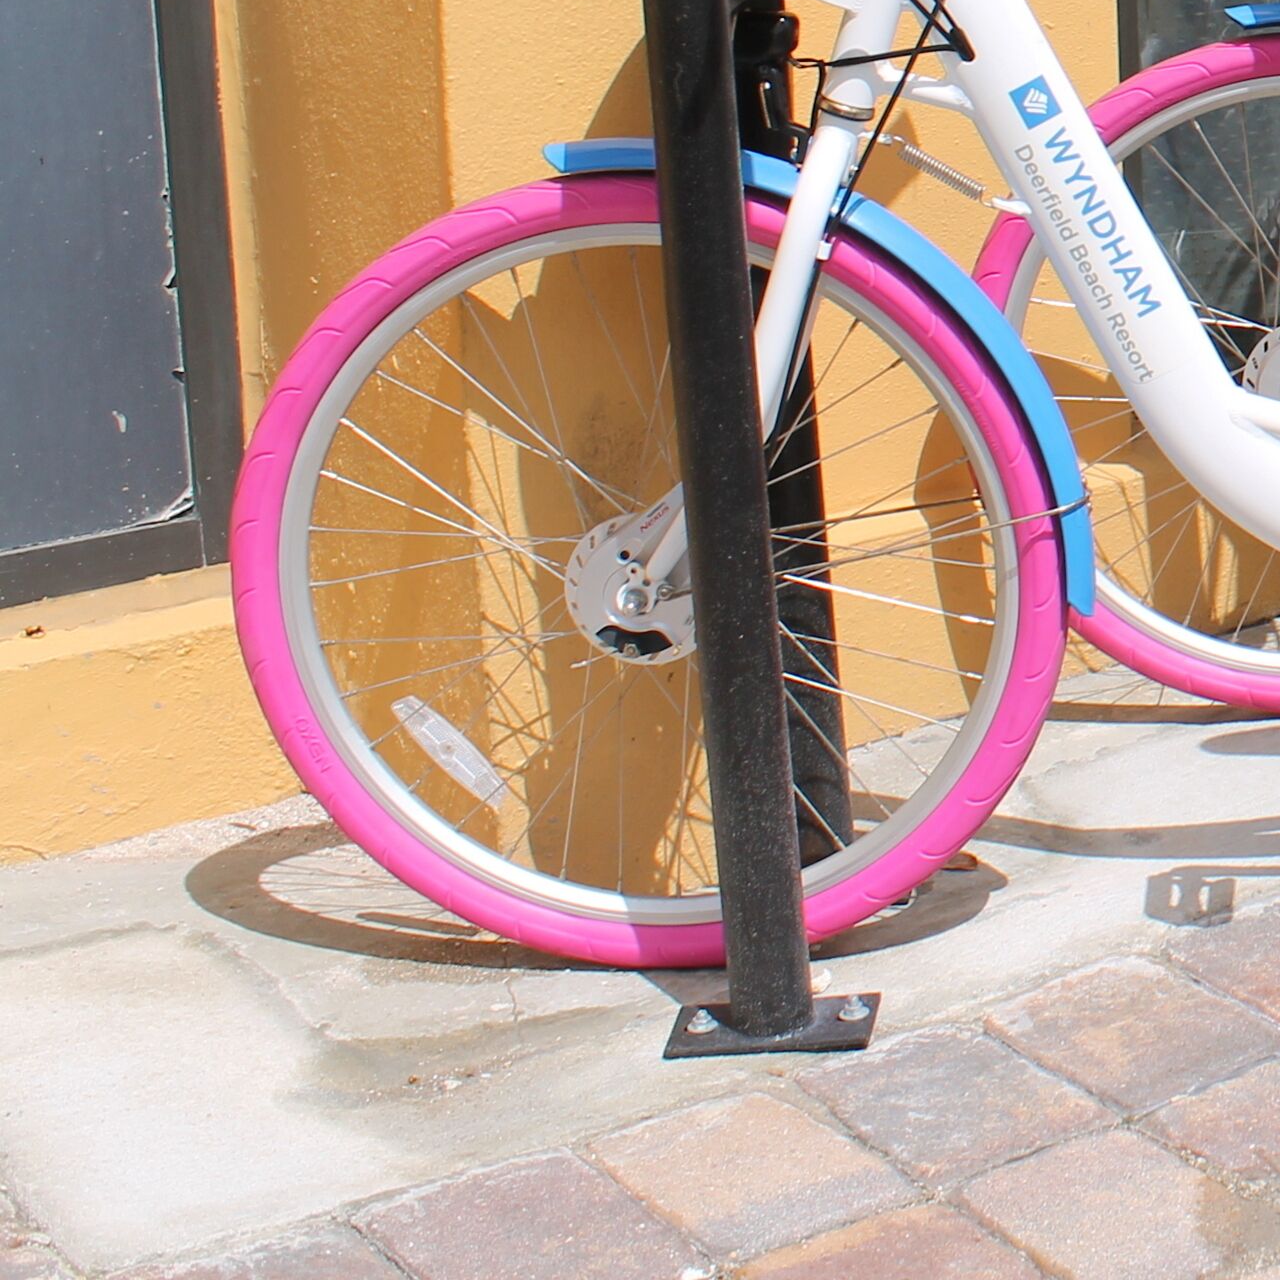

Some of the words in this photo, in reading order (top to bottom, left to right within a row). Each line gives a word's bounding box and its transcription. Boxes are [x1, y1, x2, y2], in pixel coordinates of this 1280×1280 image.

[1014, 144, 1079, 243] Deerfield
[1068, 243, 1113, 311] Beach
[1106, 312, 1155, 382] Resort
[1044, 126, 1163, 319] WYNDHAM
